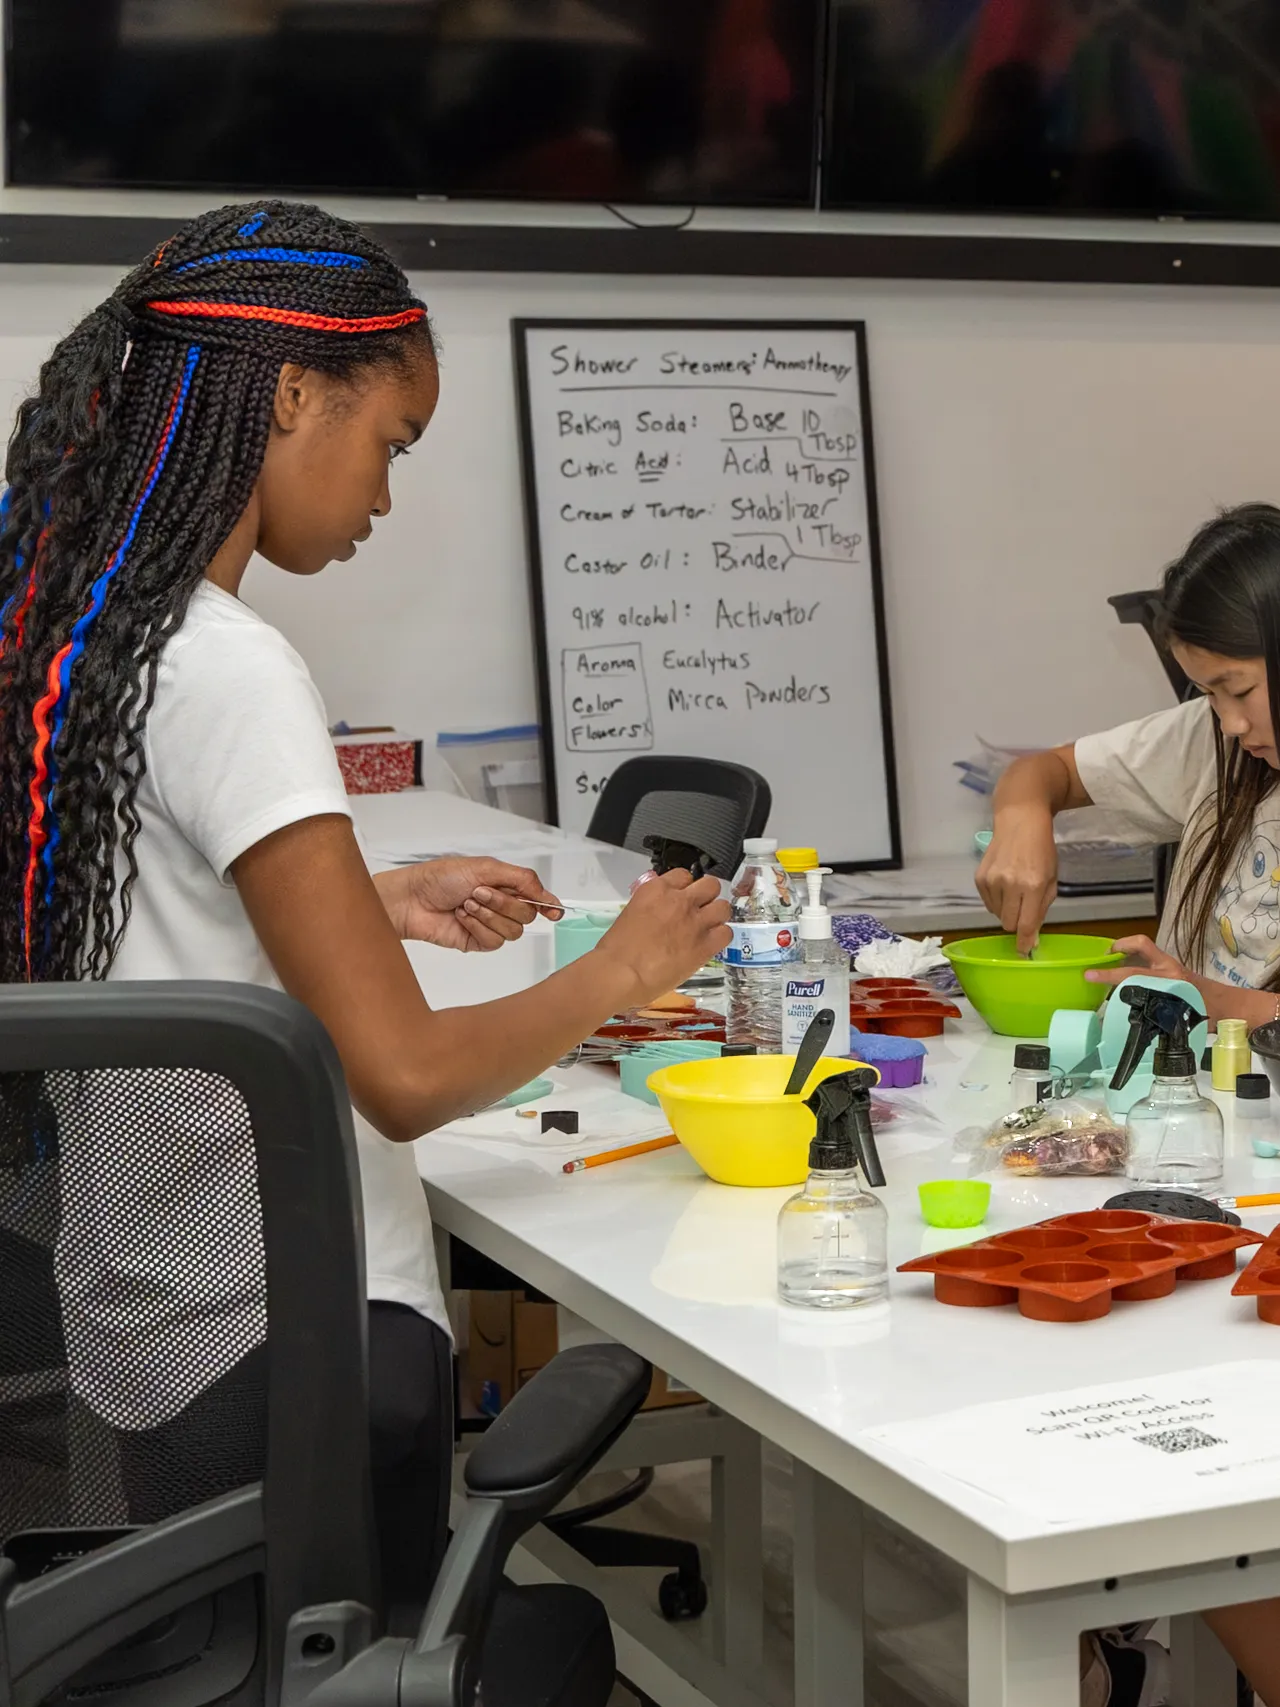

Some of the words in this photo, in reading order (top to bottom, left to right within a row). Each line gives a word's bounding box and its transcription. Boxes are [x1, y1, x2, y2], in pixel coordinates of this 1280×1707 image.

[550, 344, 638, 376] Shower
[729, 402, 787, 433] Base
[802, 408, 821, 434] 10
[807, 432, 857, 459] Tbsp
[560, 458, 618, 478] Citric
[723, 445, 773, 475] Acid
[786, 460, 798, 483] 4
[801, 463, 850, 495] Tbsp
[560, 503, 613, 522] Cream
[621, 503, 635, 519] of
[731, 490, 839, 522] Stabilizer
[811, 523, 862, 558] Tbsp
[564, 553, 628, 575] Castor
[712, 541, 796, 573] Binder
[572, 606, 605, 630] 91%
[716, 598, 821, 629] Activator
[577, 652, 636, 673] Aroma
[572, 693, 623, 714] Color
[745, 675, 831, 710] Powders
[571, 723, 642, 746] Flowers
[788, 982, 821, 996] Purell
[787, 1010, 816, 1018] SANITIZ
[1026, 1421, 1082, 1435] Scan
[1084, 1413, 1121, 1425] QR
[1122, 1404, 1180, 1418] Code
[1180, 1397, 1213, 1407] for
[1040, 1393, 1155, 1418] Welcome!
[1140, 1412, 1215, 1430] Access
